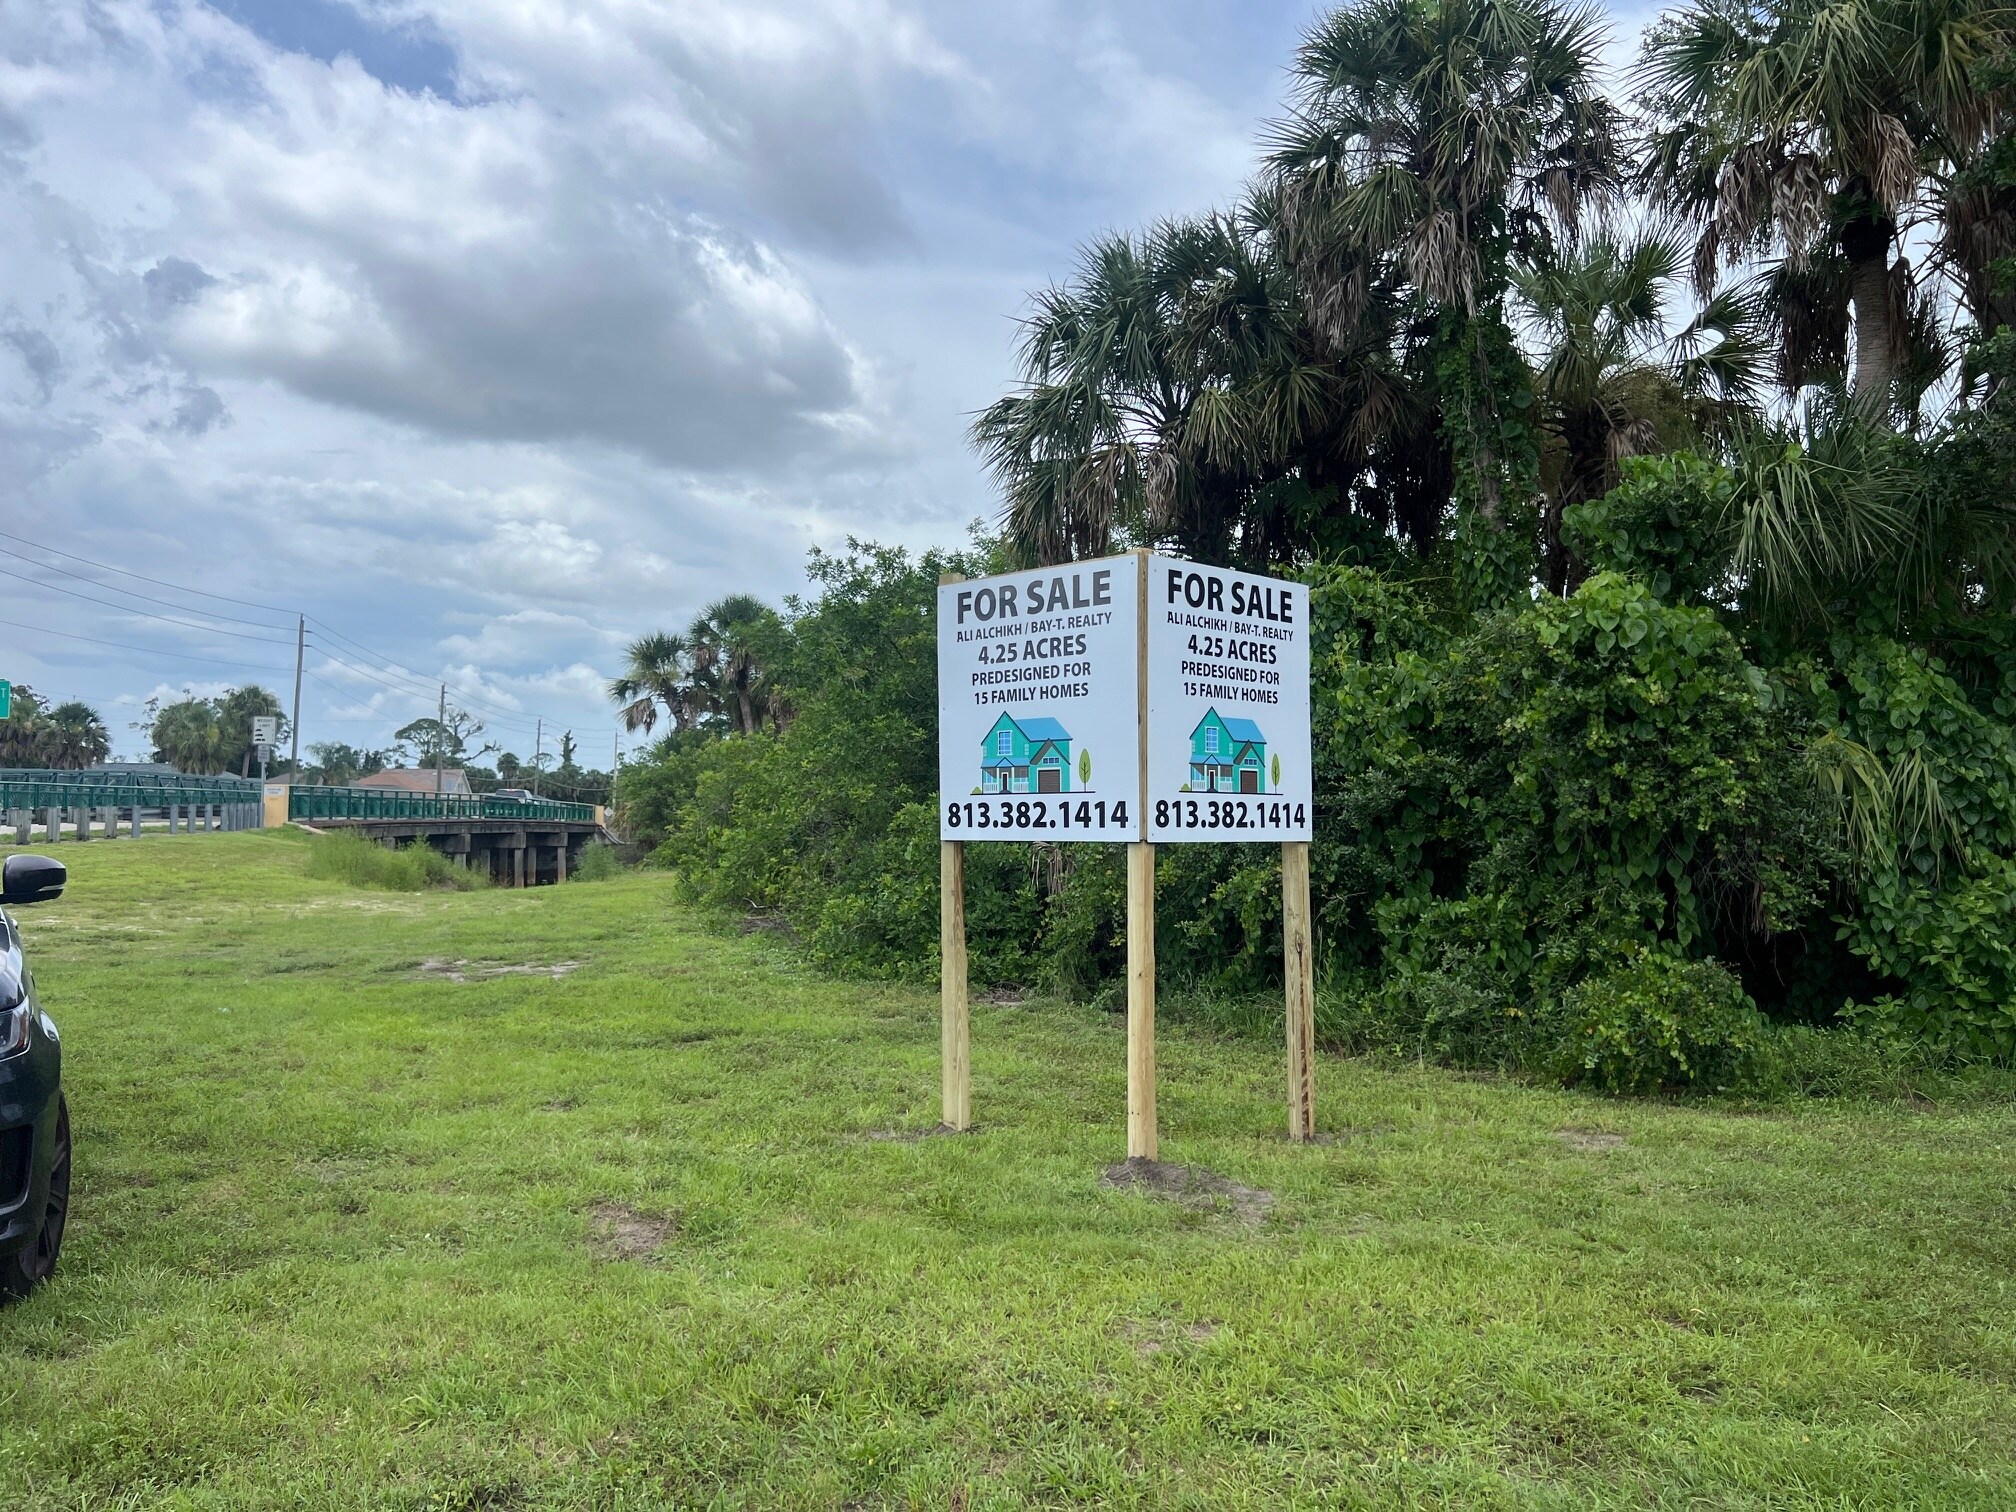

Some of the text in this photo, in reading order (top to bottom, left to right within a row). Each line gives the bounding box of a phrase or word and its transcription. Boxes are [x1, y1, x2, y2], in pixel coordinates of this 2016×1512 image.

[957, 570, 1111, 624] FOR SALE
[1168, 569, 1293, 624] FOR SALE
[956, 612, 1112, 643] ALI ALCHIKH / BAY-T. REALTY
[1167, 611, 1293, 642] ALI ALCHIKH / BAY-T. REALTY
[978, 633, 1087, 665] 4.25 ACRES
[1188, 634, 1277, 665] 4.25 ACRES
[972, 662, 1091, 686] PREDESIGNED FOR
[1181, 660, 1280, 685] PREDESIGNED FOR
[974, 682, 1089, 705] 15 FAMILY HOMES
[1183, 682, 1278, 704] 15 FAMILY HOMES
[948, 801, 1129, 828] 813.382.1414
[1155, 800, 1306, 829] 813.382.1414
